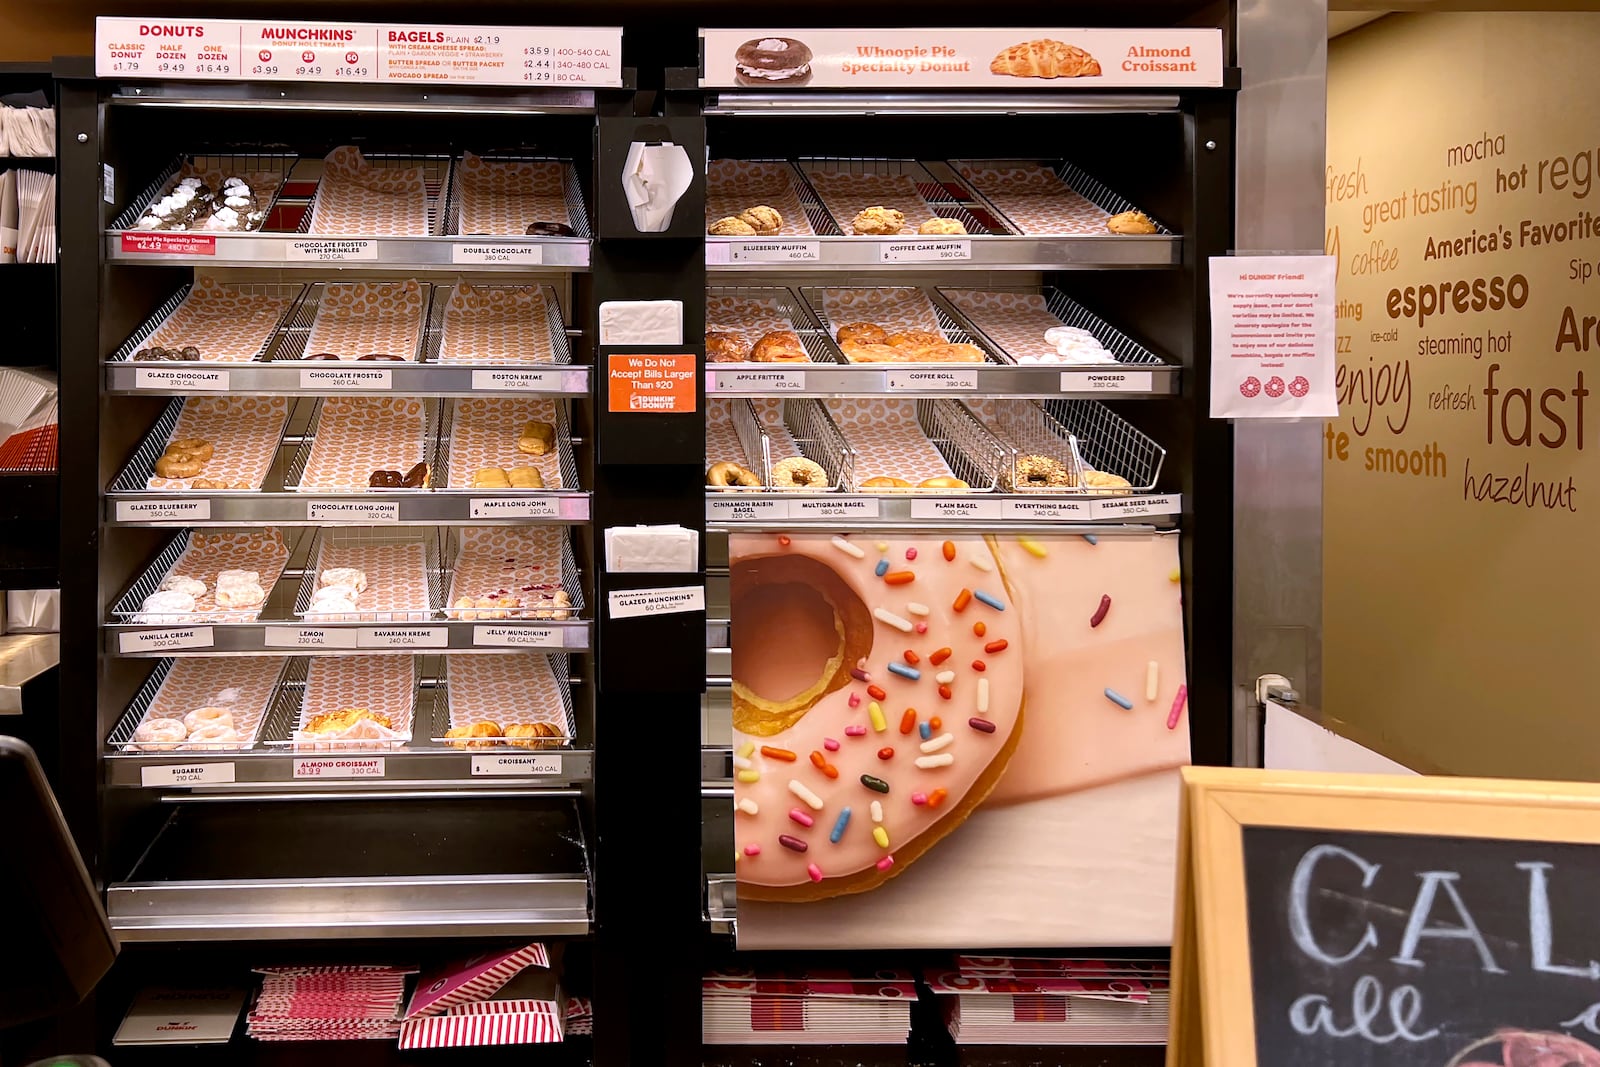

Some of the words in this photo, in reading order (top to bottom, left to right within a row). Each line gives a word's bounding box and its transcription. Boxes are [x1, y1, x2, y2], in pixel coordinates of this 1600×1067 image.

[140, 25, 204, 37] DONUTS
[388, 31, 444, 42] BAGELS
[108, 43, 145, 51] CLASSIC
[856, 46, 927, 58] Whoopie
[932, 46, 956, 57] Pie
[1128, 46, 1191, 57] Almond
[113, 62, 139, 70] $1.79
[158, 63, 184, 72] $9.49
[196, 64, 230, 73] $16.49
[253, 65, 278, 74] $3.99
[296, 66, 322, 74] $9.49
[336, 67, 367, 76] $16.49
[524, 72, 550, 80] $1.29
[841, 61, 915, 75] Specialty
[920, 61, 970, 72] Donut
[1122, 60, 1197, 72] Croissant
[1447, 132, 1506, 167] mocha
[1496, 164, 1528, 194] hot
[1538, 146, 1600, 199] reg
[1363, 191, 1407, 234] great
[1413, 180, 1477, 214] tasting
[1424, 225, 1513, 261] America's
[1351, 240, 1399, 276] coffee
[1569, 258, 1592, 285] Sip
[1386, 273, 1529, 328] espresso
[1370, 328, 1398, 343] ice-cold
[1418, 333, 1482, 359] steaming
[1487, 330, 1512, 354] hot
[628, 358, 642, 367] We
[645, 358, 658, 367] Do
[660, 359, 676, 367] Not
[611, 370, 642, 380] Accept
[644, 370, 662, 378] Bills
[664, 371, 694, 380] Larger
[632, 381, 654, 389] Than
[656, 381, 673, 389] $20
[1336, 356, 1411, 437] enjoy
[1428, 384, 1476, 411] refresh
[1483, 364, 1589, 451] fast
[1365, 442, 1447, 478] smooth
[1464, 458, 1577, 512] hazelnut
[620, 598, 646, 606] GLAZED
[1289, 976, 1441, 1044] all
